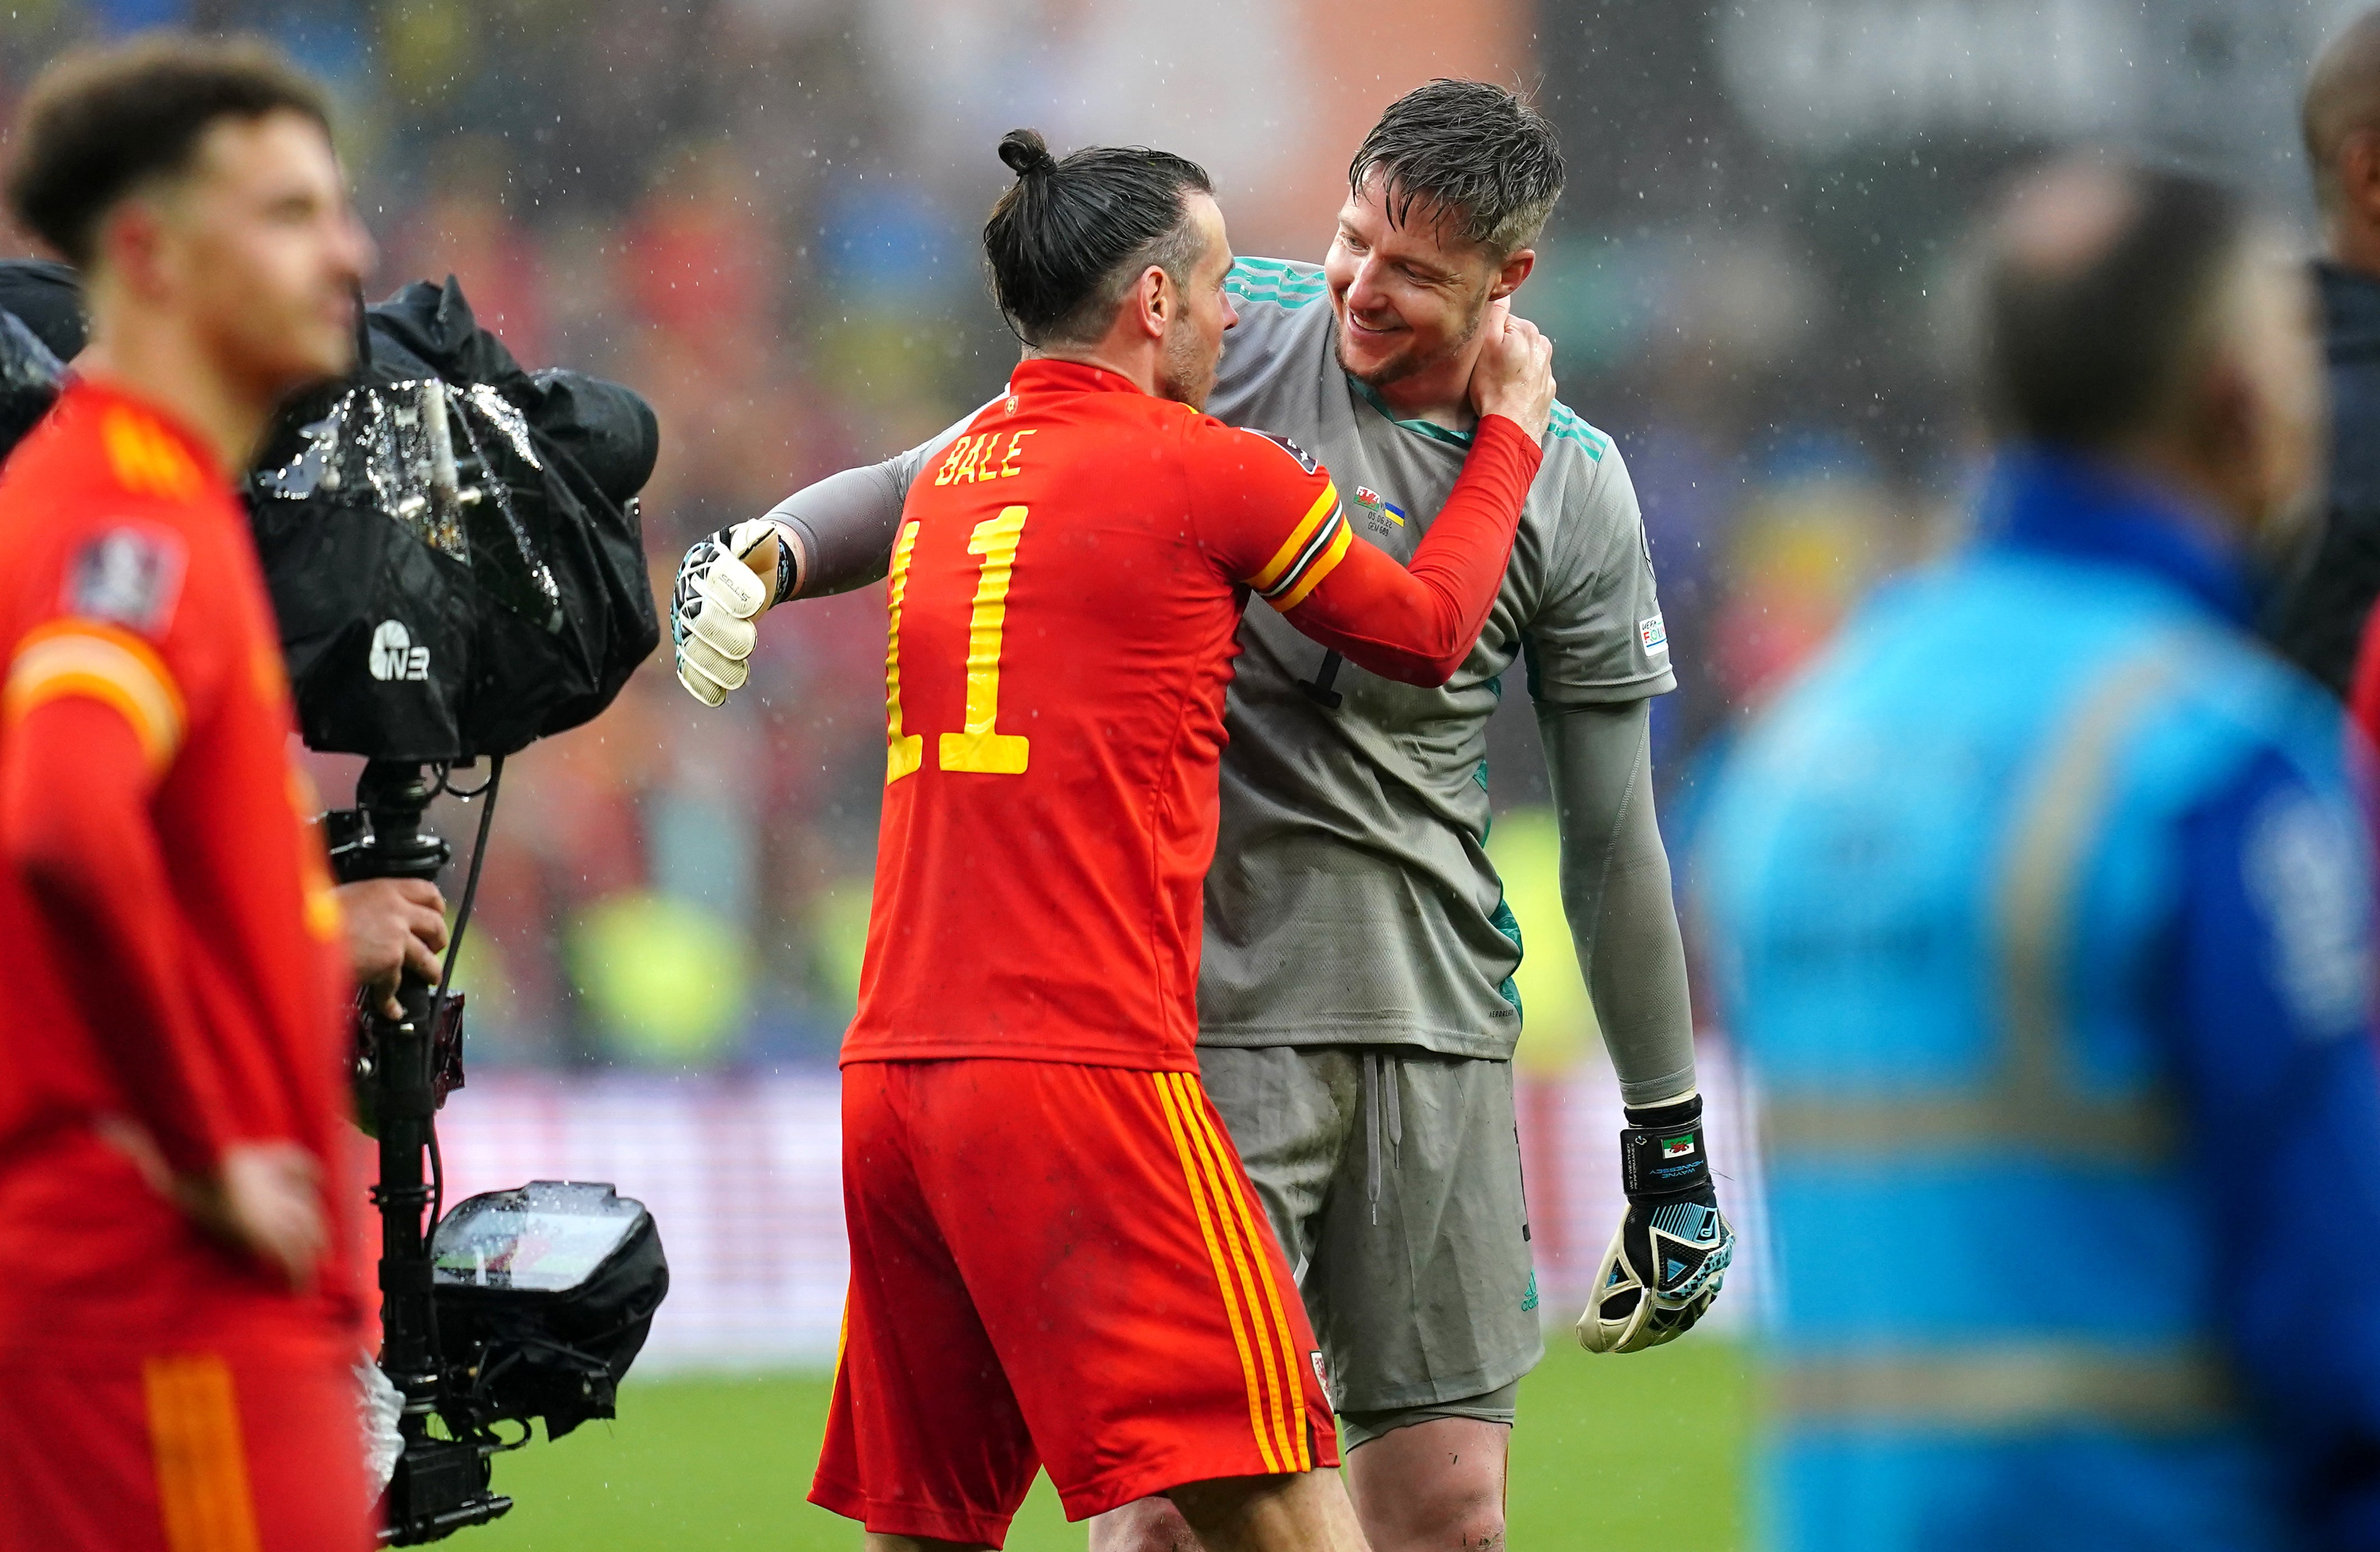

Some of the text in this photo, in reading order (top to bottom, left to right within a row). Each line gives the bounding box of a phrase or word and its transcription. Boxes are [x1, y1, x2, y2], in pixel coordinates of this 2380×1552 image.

[935, 429, 1037, 486] BALE
[886, 505, 1030, 785] 11
[1662, 1168, 1696, 1179] WAYNE
